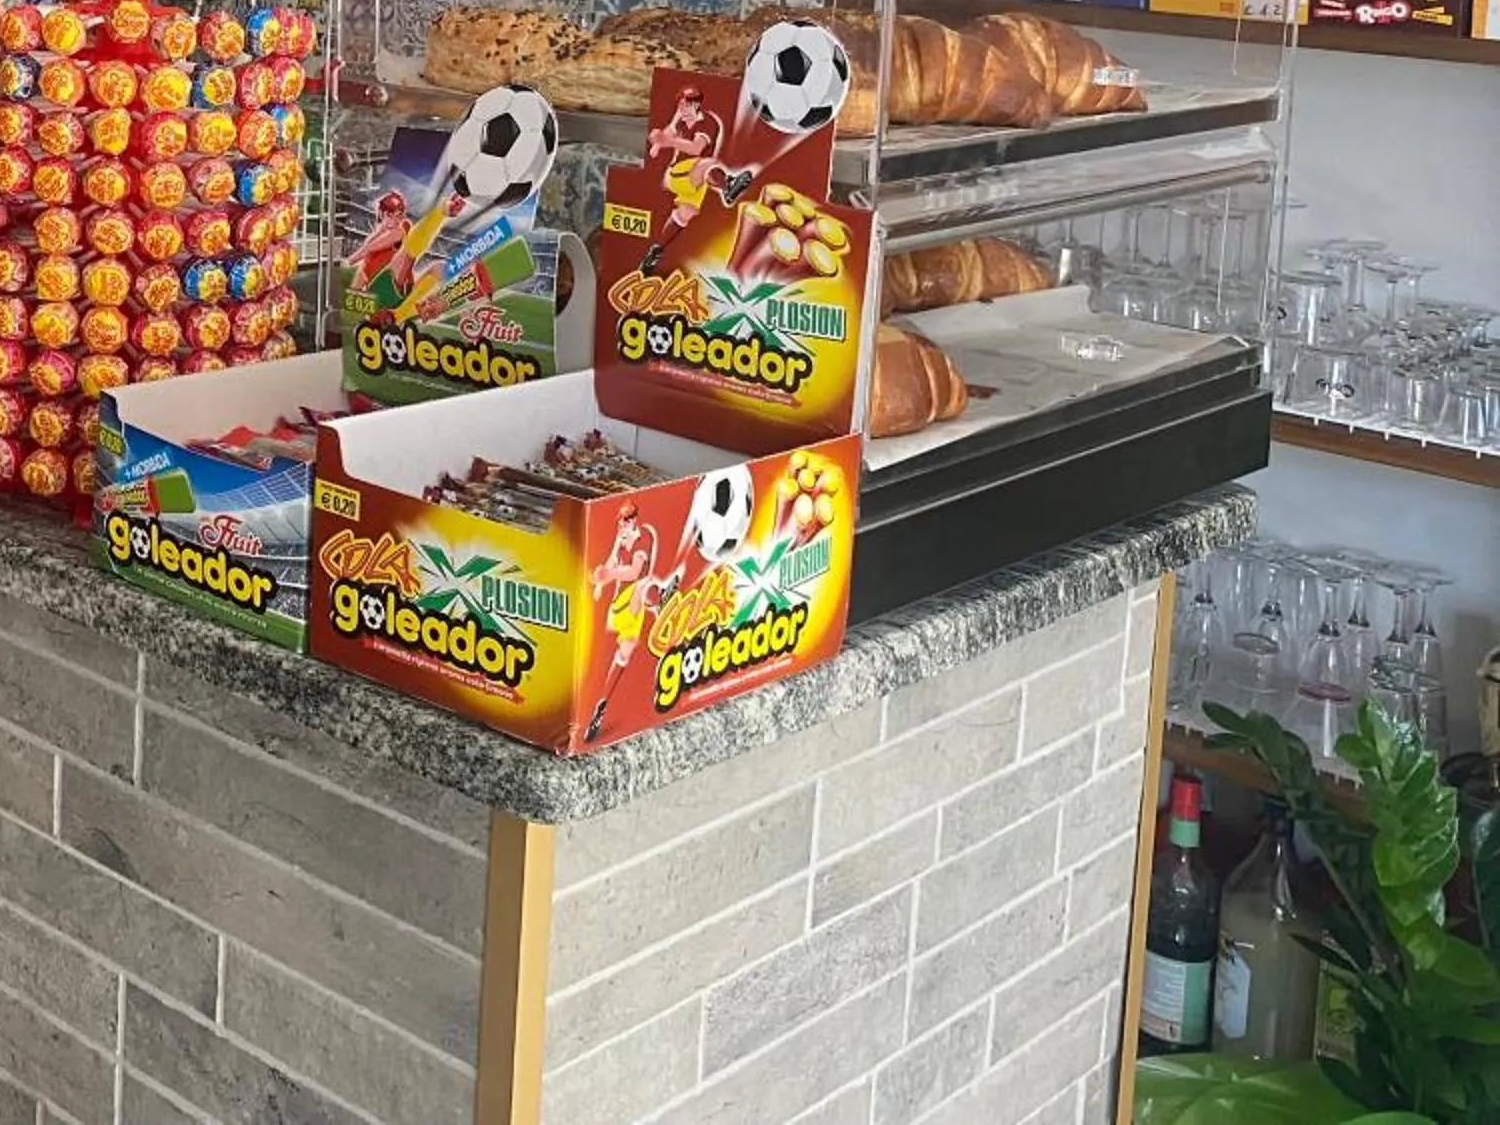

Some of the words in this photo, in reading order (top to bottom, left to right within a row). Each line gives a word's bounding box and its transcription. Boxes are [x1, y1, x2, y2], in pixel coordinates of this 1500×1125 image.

[459, 305, 524, 345] Fruit
[607, 269, 710, 324] COLA
[356, 324, 538, 387] goleador
[619, 314, 810, 389] goleador
[107, 514, 275, 609] goleador
[198, 513, 263, 556] Fruit
[318, 528, 421, 599] COLA
[332, 581, 530, 681] goleador
[648, 567, 736, 658] COLA
[656, 605, 808, 709] goleador
